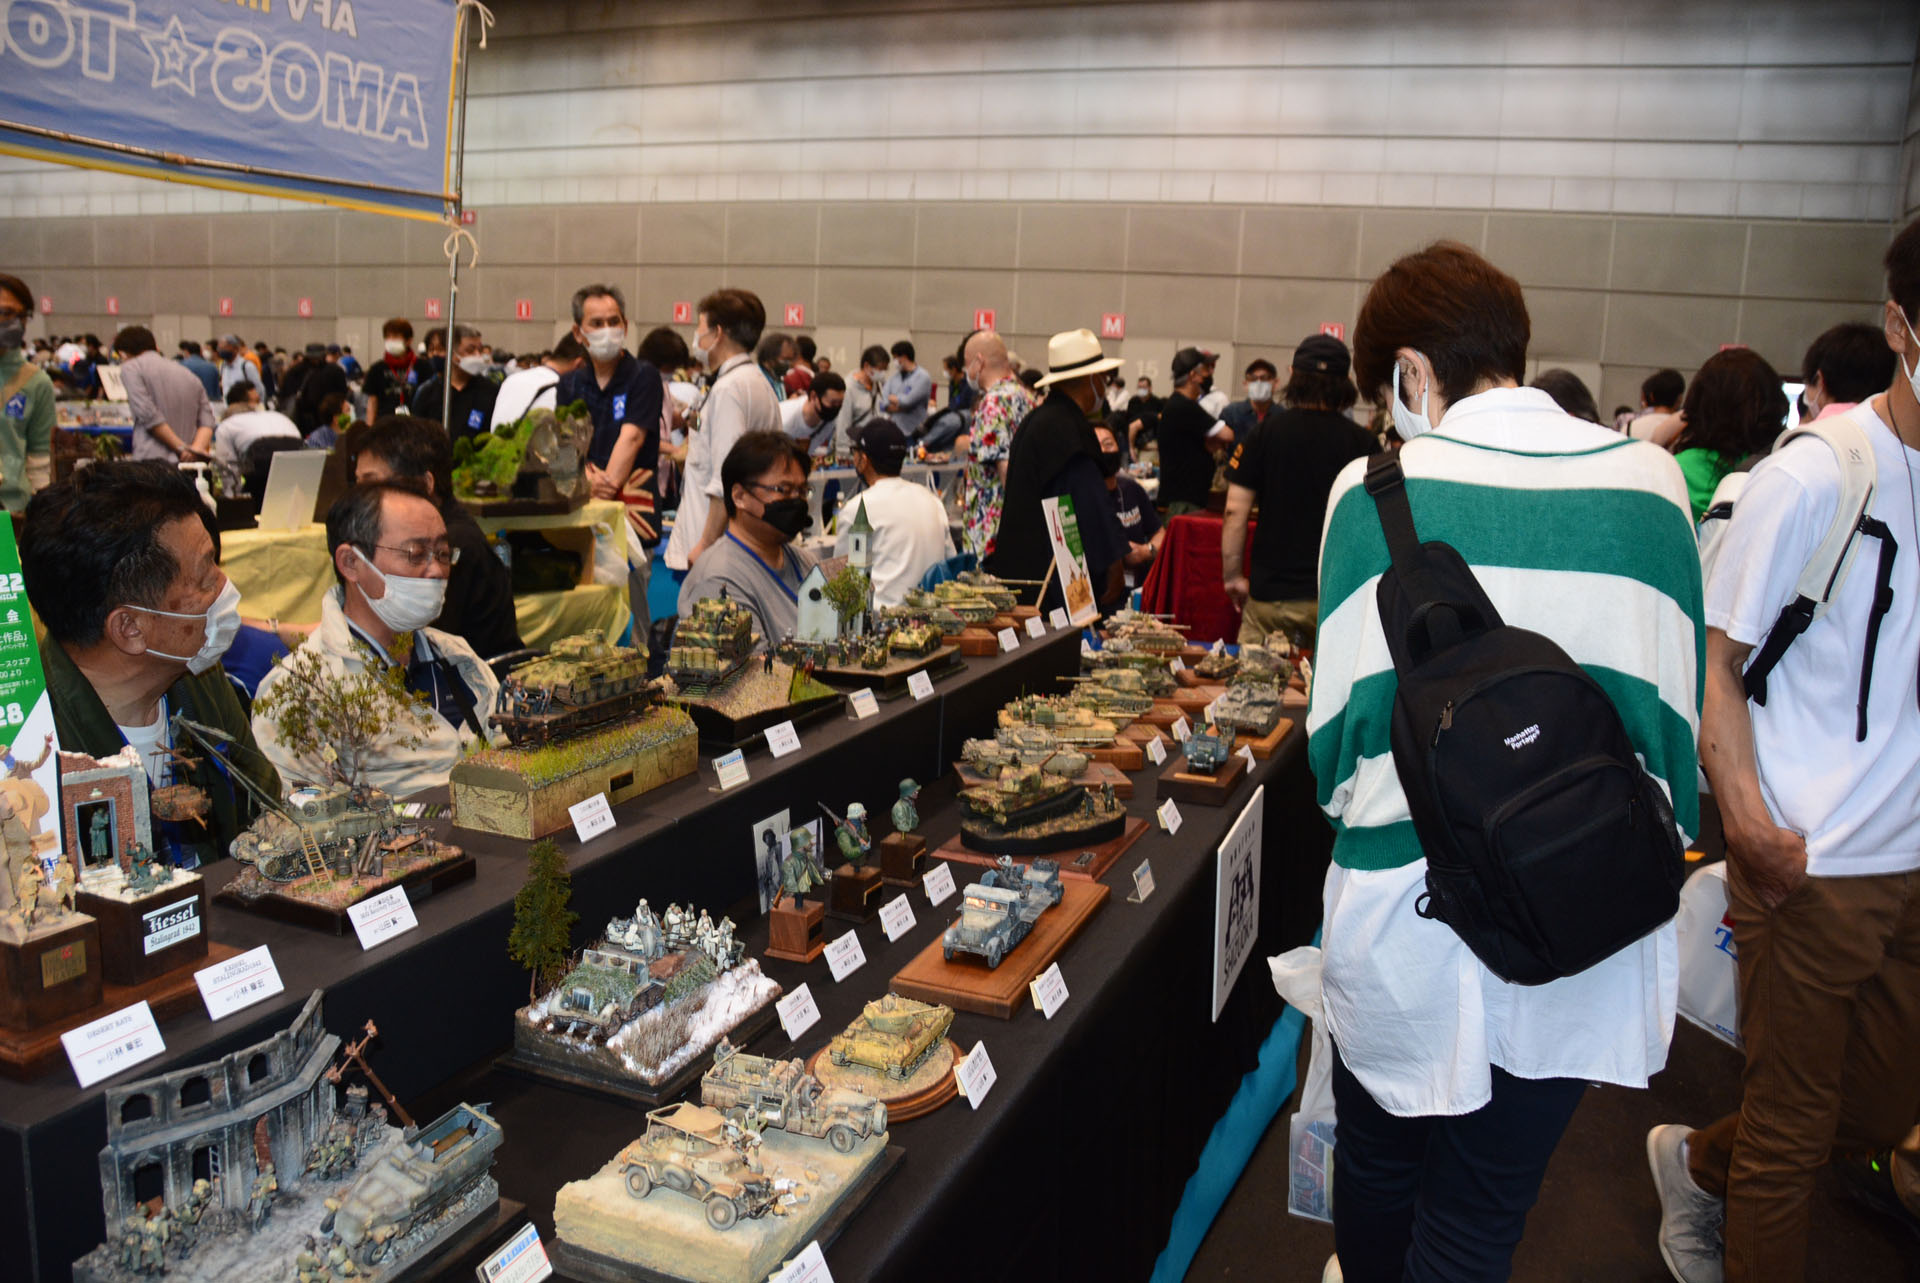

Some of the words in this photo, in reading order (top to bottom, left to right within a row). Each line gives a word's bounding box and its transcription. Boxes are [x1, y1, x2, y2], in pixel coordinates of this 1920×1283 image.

[427, 301, 439, 316] H
[677, 304, 687, 321] J
[788, 307, 800, 323] K
[979, 312, 991, 329] L
[1105, 317, 1122, 333] M
[1503, 723, 1539, 747] Manhattan
[150, 903, 195, 933] Kessel
